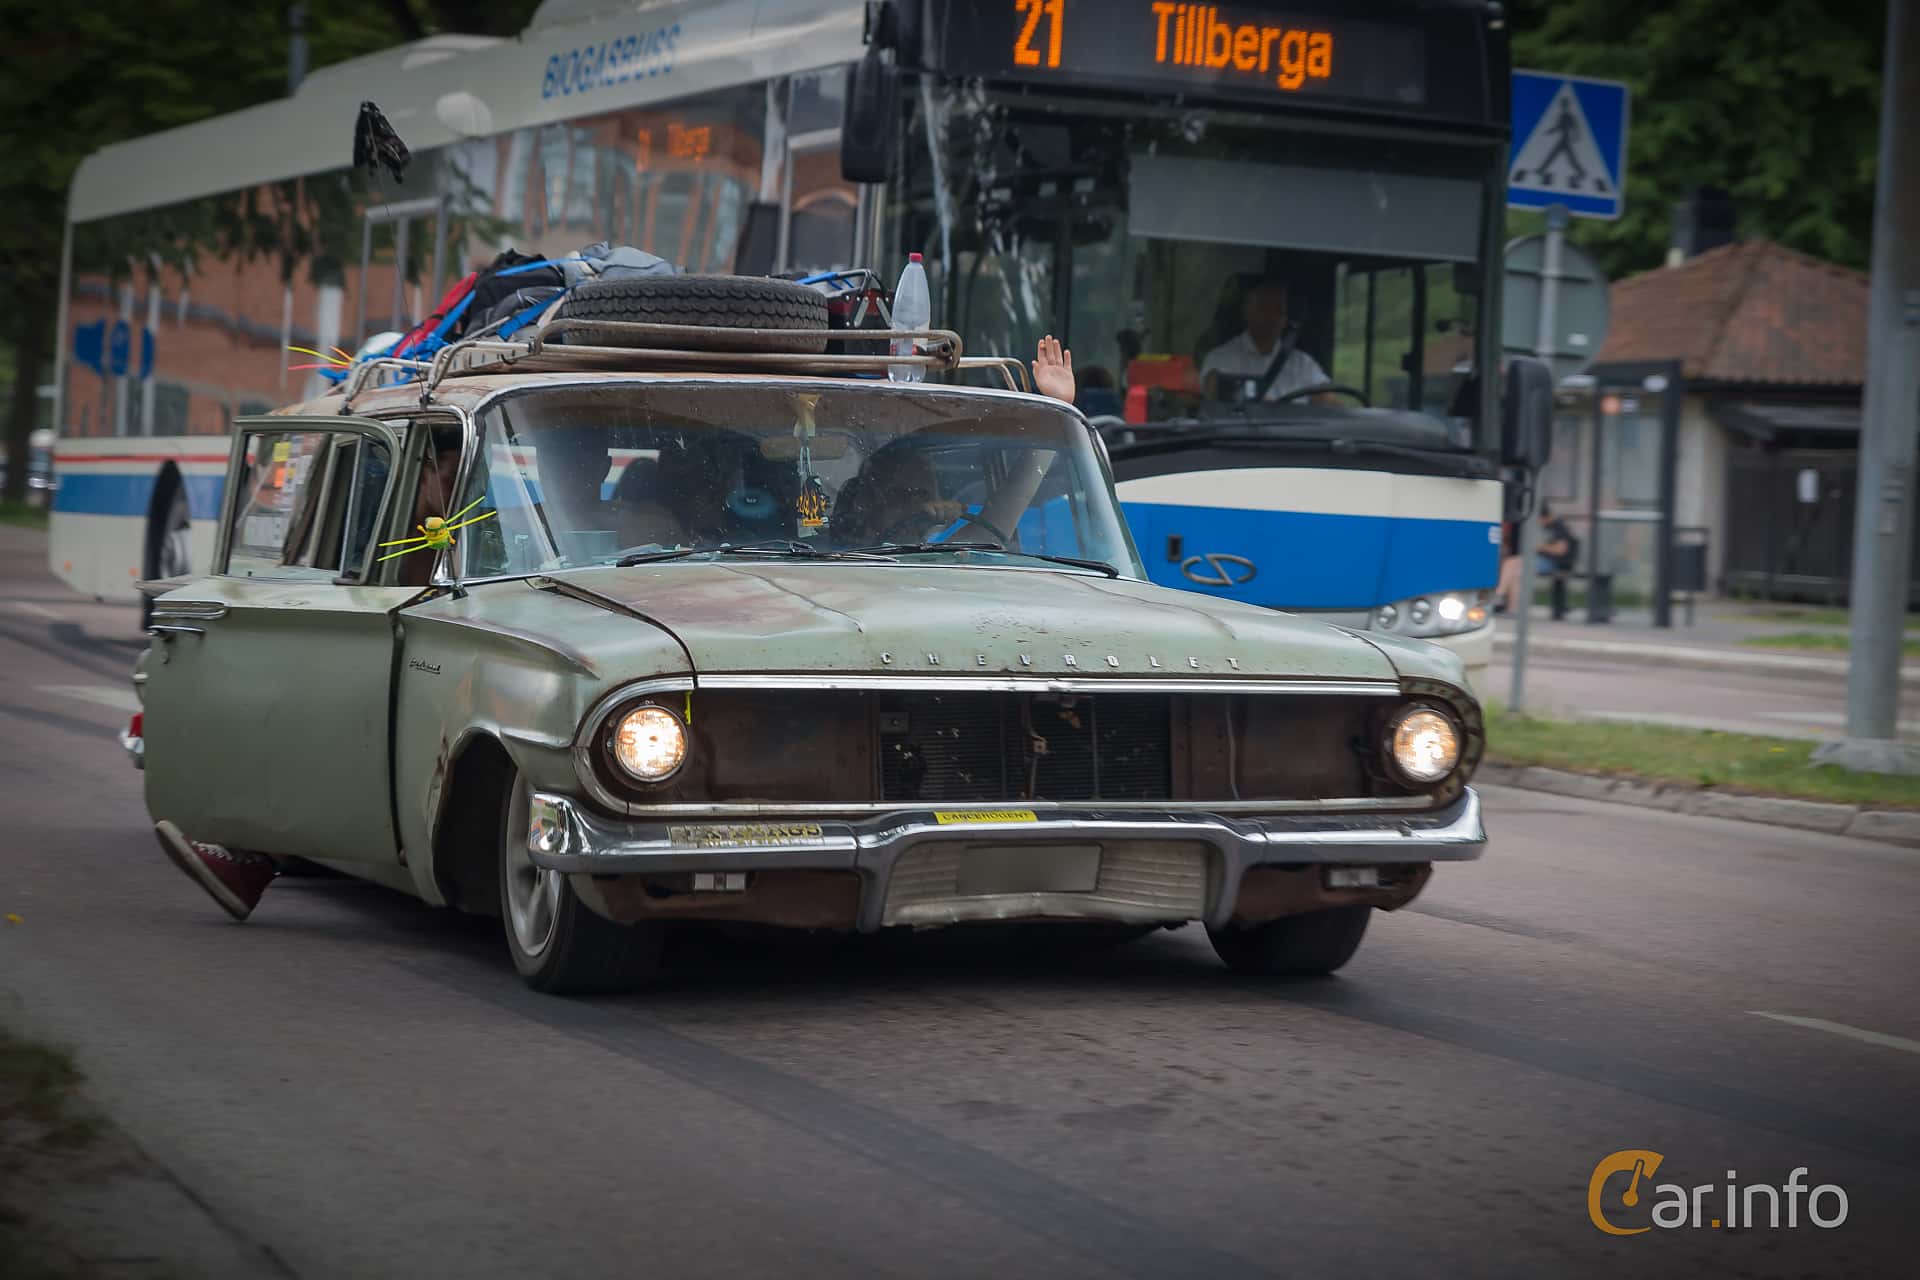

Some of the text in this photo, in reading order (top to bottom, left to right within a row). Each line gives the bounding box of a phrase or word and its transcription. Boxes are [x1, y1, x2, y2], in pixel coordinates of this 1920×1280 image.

[543, 22, 681, 99] BIOGASBUSS
[1014, 0, 1333, 91] 21 Tillberga
[880, 652, 1239, 670] CHEVROLET
